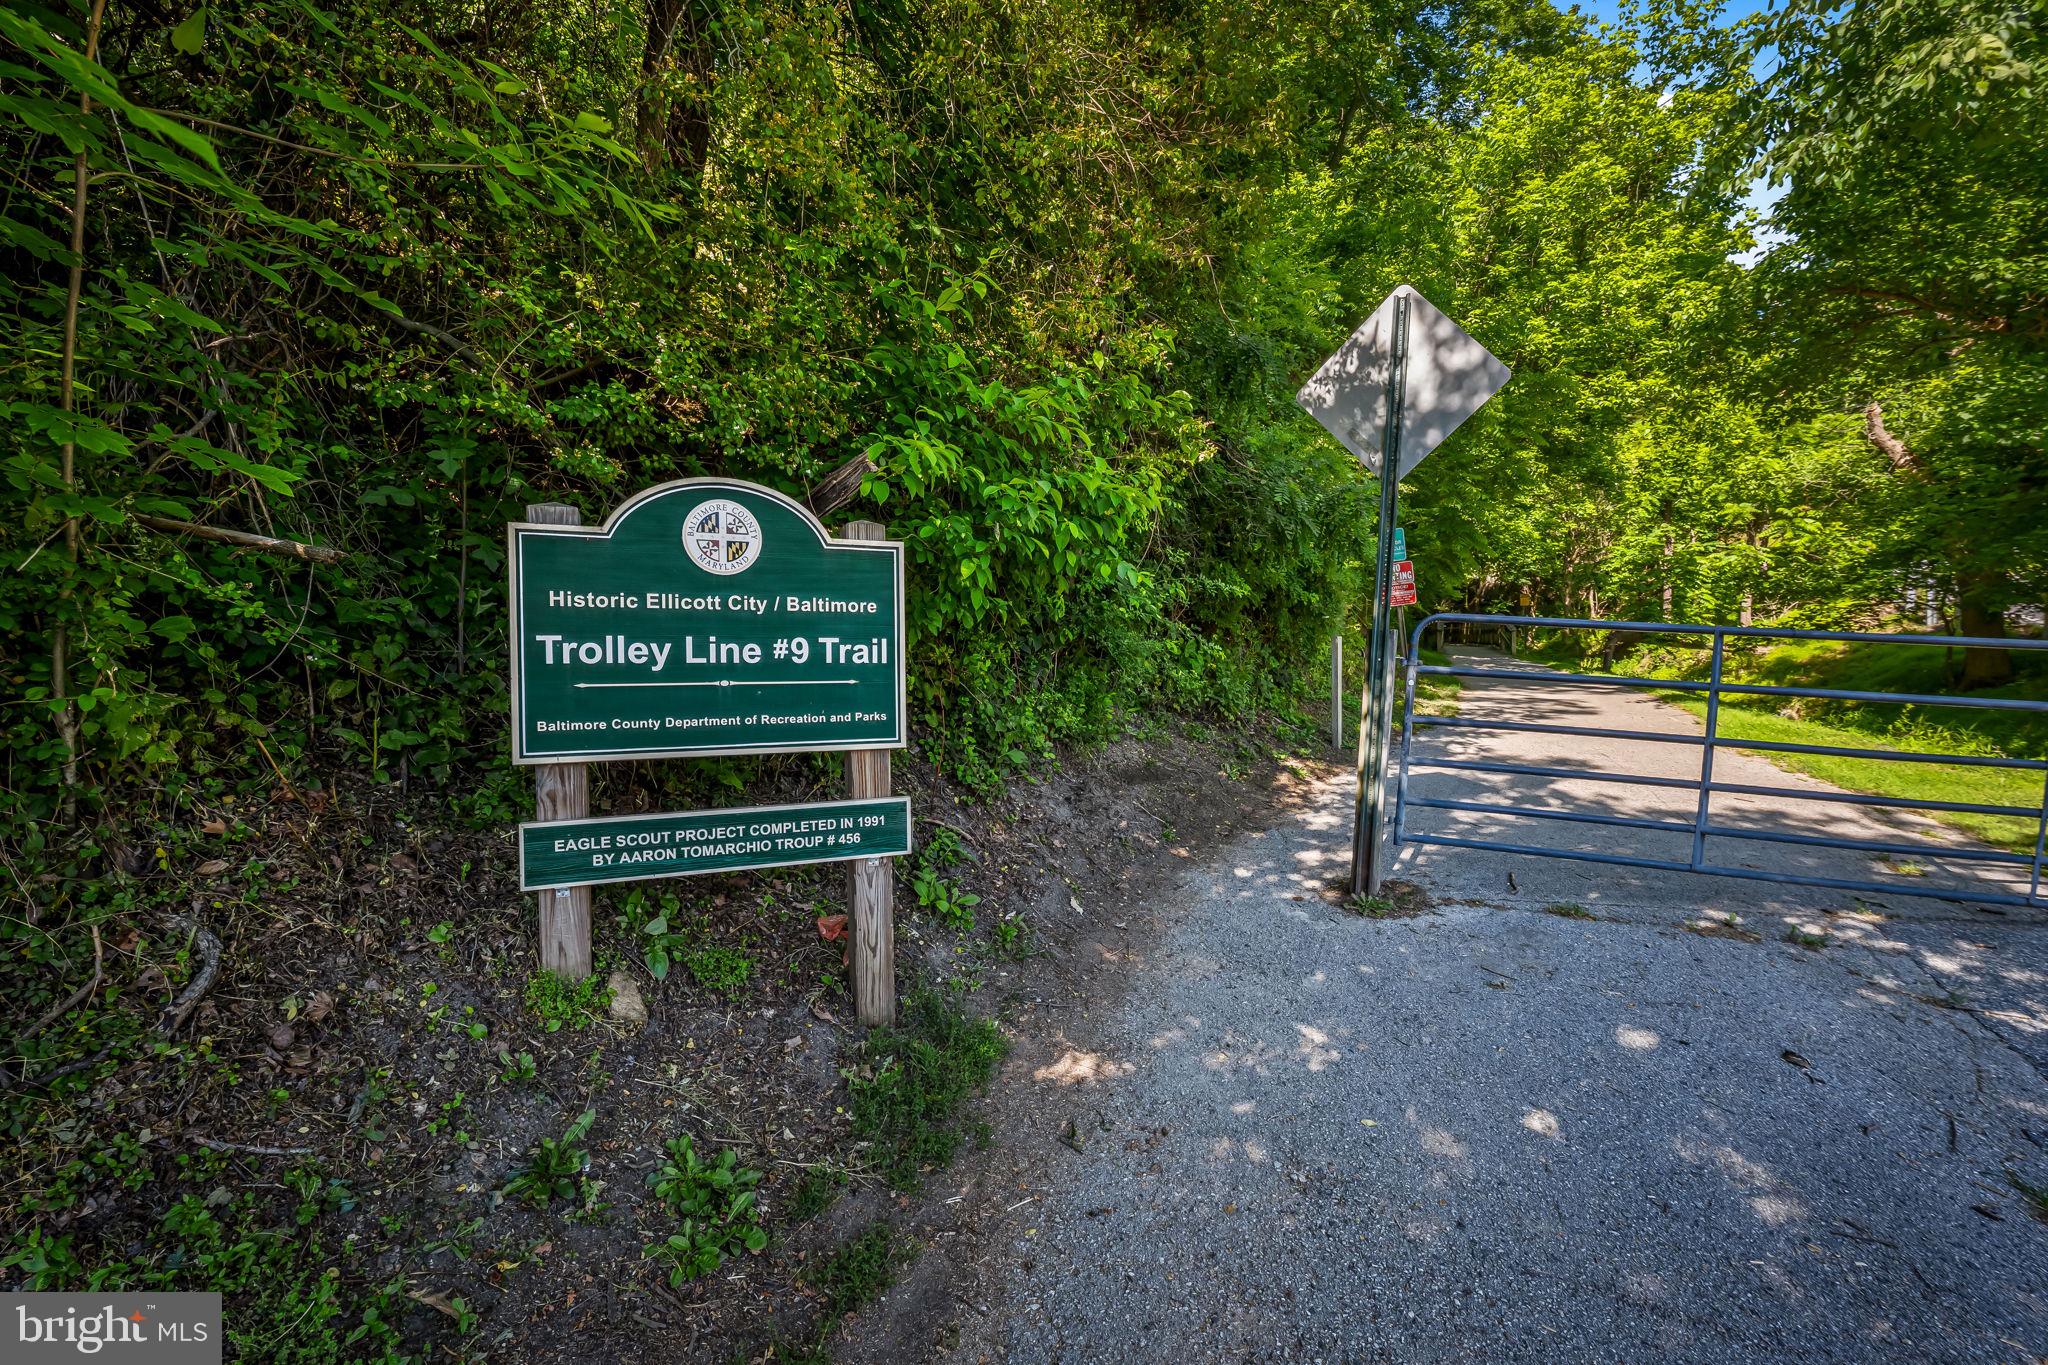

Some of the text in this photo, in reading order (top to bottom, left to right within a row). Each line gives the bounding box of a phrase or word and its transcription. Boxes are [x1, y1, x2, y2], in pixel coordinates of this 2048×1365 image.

[687, 503, 758, 540] BALTIMORE COUNTY
[697, 553, 749, 571] MARYLAND
[549, 590, 638, 609] Historic
[646, 593, 722, 611] Ellicott
[727, 595, 768, 615] City
[786, 596, 877, 613] Baltimore
[535, 634, 888, 672] Trolley Line #9 Trail
[536, 711, 887, 732] Baltimore County Department of Recreation and Parks
[554, 815, 885, 853] EAGLE SCOUT PROJECT COMPLETED IN 1991
[592, 832, 861, 867] BY AARON TOMARCHIO TROUP # 456
